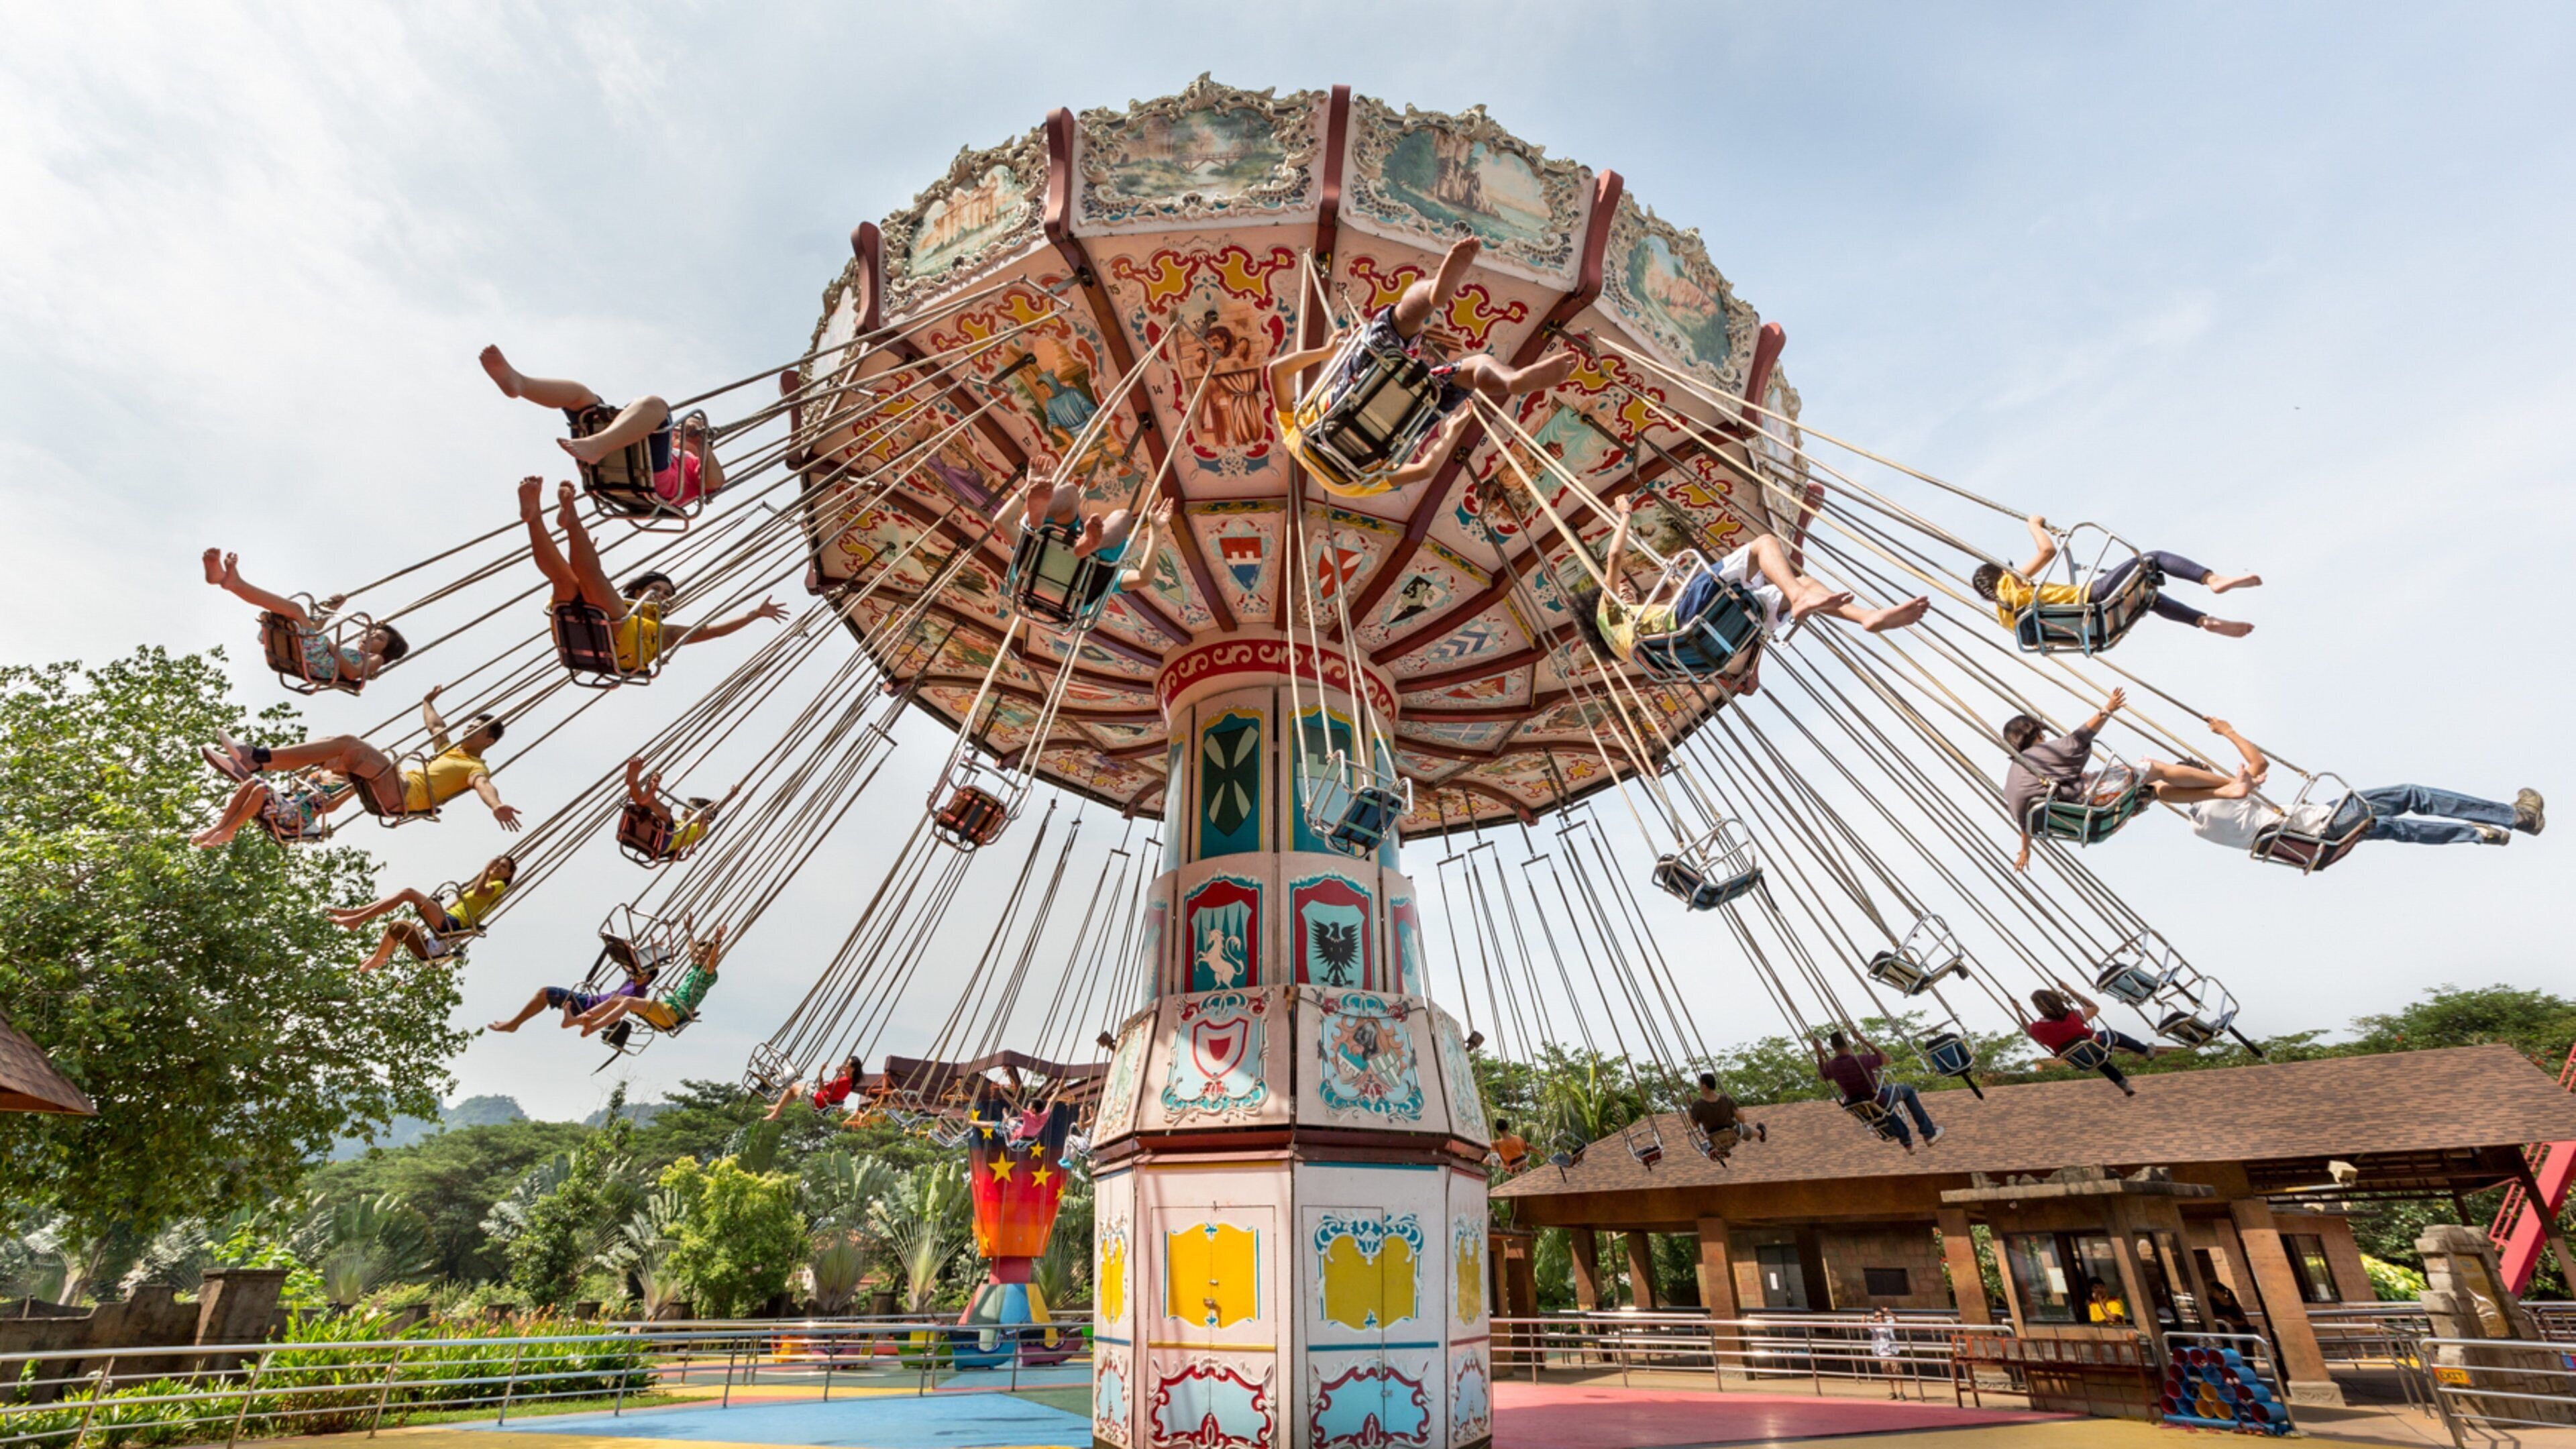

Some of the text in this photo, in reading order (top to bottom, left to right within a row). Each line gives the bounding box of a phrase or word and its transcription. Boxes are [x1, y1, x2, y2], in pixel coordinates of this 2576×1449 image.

[1108, 283, 1120, 295] 15
[1152, 385, 1163, 394] 14
[1479, 437, 1488, 447] 8
[2439, 1371, 2465, 1381] EXIT
